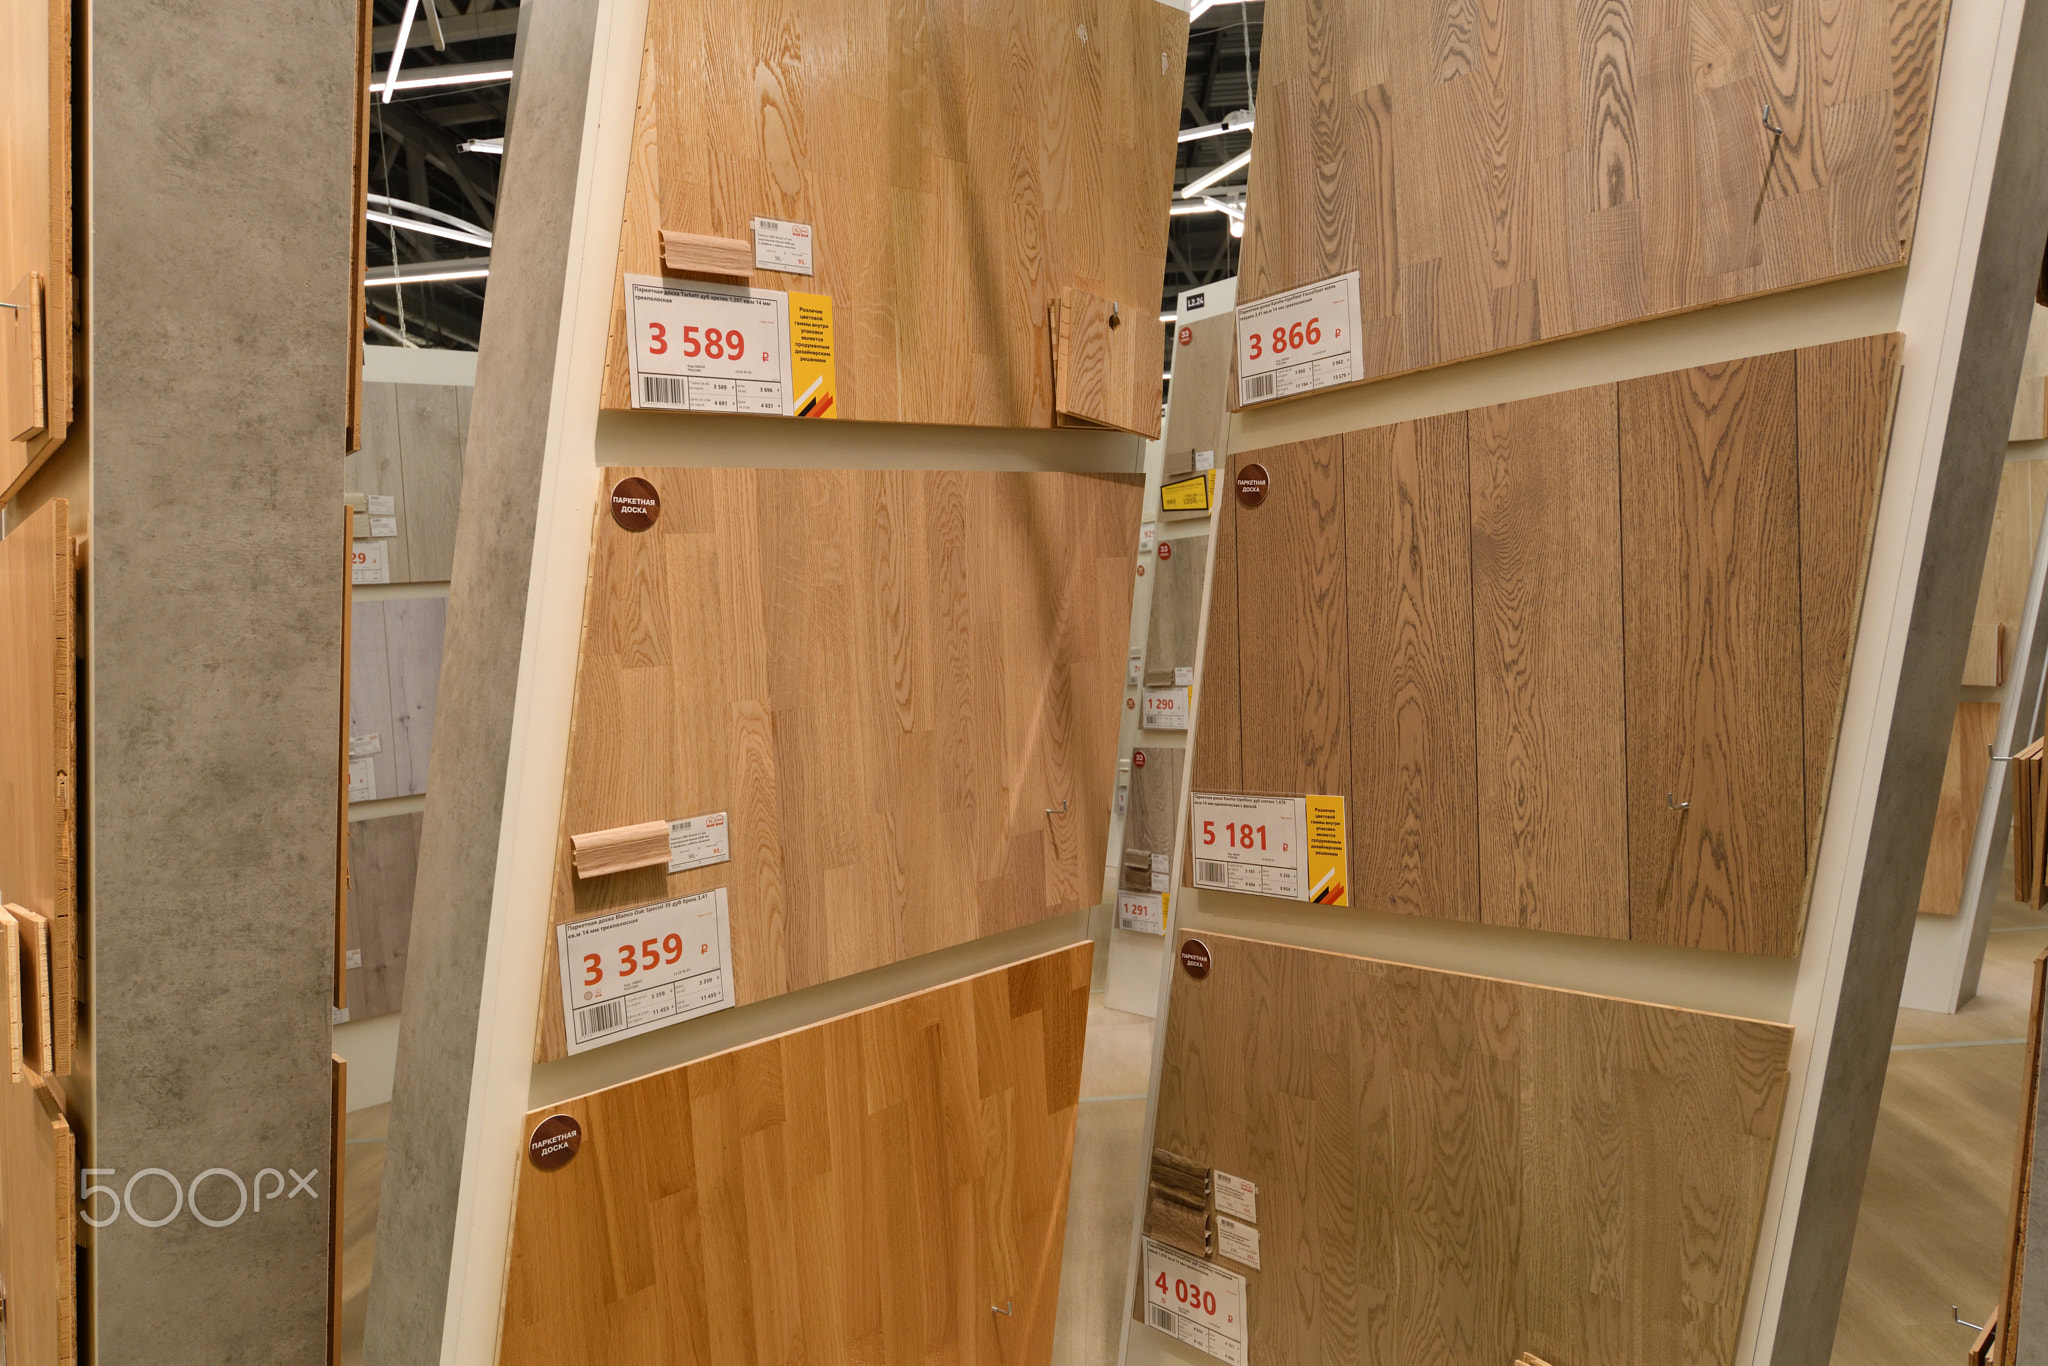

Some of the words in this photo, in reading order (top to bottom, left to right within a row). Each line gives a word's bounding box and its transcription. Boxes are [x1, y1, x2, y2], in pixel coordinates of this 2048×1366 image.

[634, 286, 663, 294] Паркетная
[635, 295, 672, 303] трехполосная
[800, 306, 823, 314] Различие
[649, 322, 668, 354] 3
[684, 326, 744, 360] 589
[1250, 334, 1262, 360] 3
[1272, 318, 1321, 354] 866
[613, 497, 655, 506] ПАРКЕТНАЯ
[621, 506, 647, 514] ДОСКА
[1148, 698, 1152, 709] 1
[1156, 699, 1174, 709] 290
[1204, 821, 1216, 846] 5
[1226, 822, 1266, 850] 181
[1124, 904, 1128, 913] 1
[1132, 904, 1147, 916] 291
[568, 921, 597, 931] Паркетная
[598, 916, 614, 924] доска
[616, 912, 633, 920] Blanco
[646, 905, 663, 913] Special
[601, 919, 638, 932] трехполосная
[583, 953, 604, 986] 3
[618, 933, 683, 977] 359
[1182, 953, 1207, 962] ПАРКЕТНАЯ
[532, 1130, 577, 1150] ПАРКЕТНАЯ
[541, 1142, 568, 1157] ДОСКА
[1155, 1272, 1168, 1294] 4
[1175, 1278, 1216, 1316] 030
